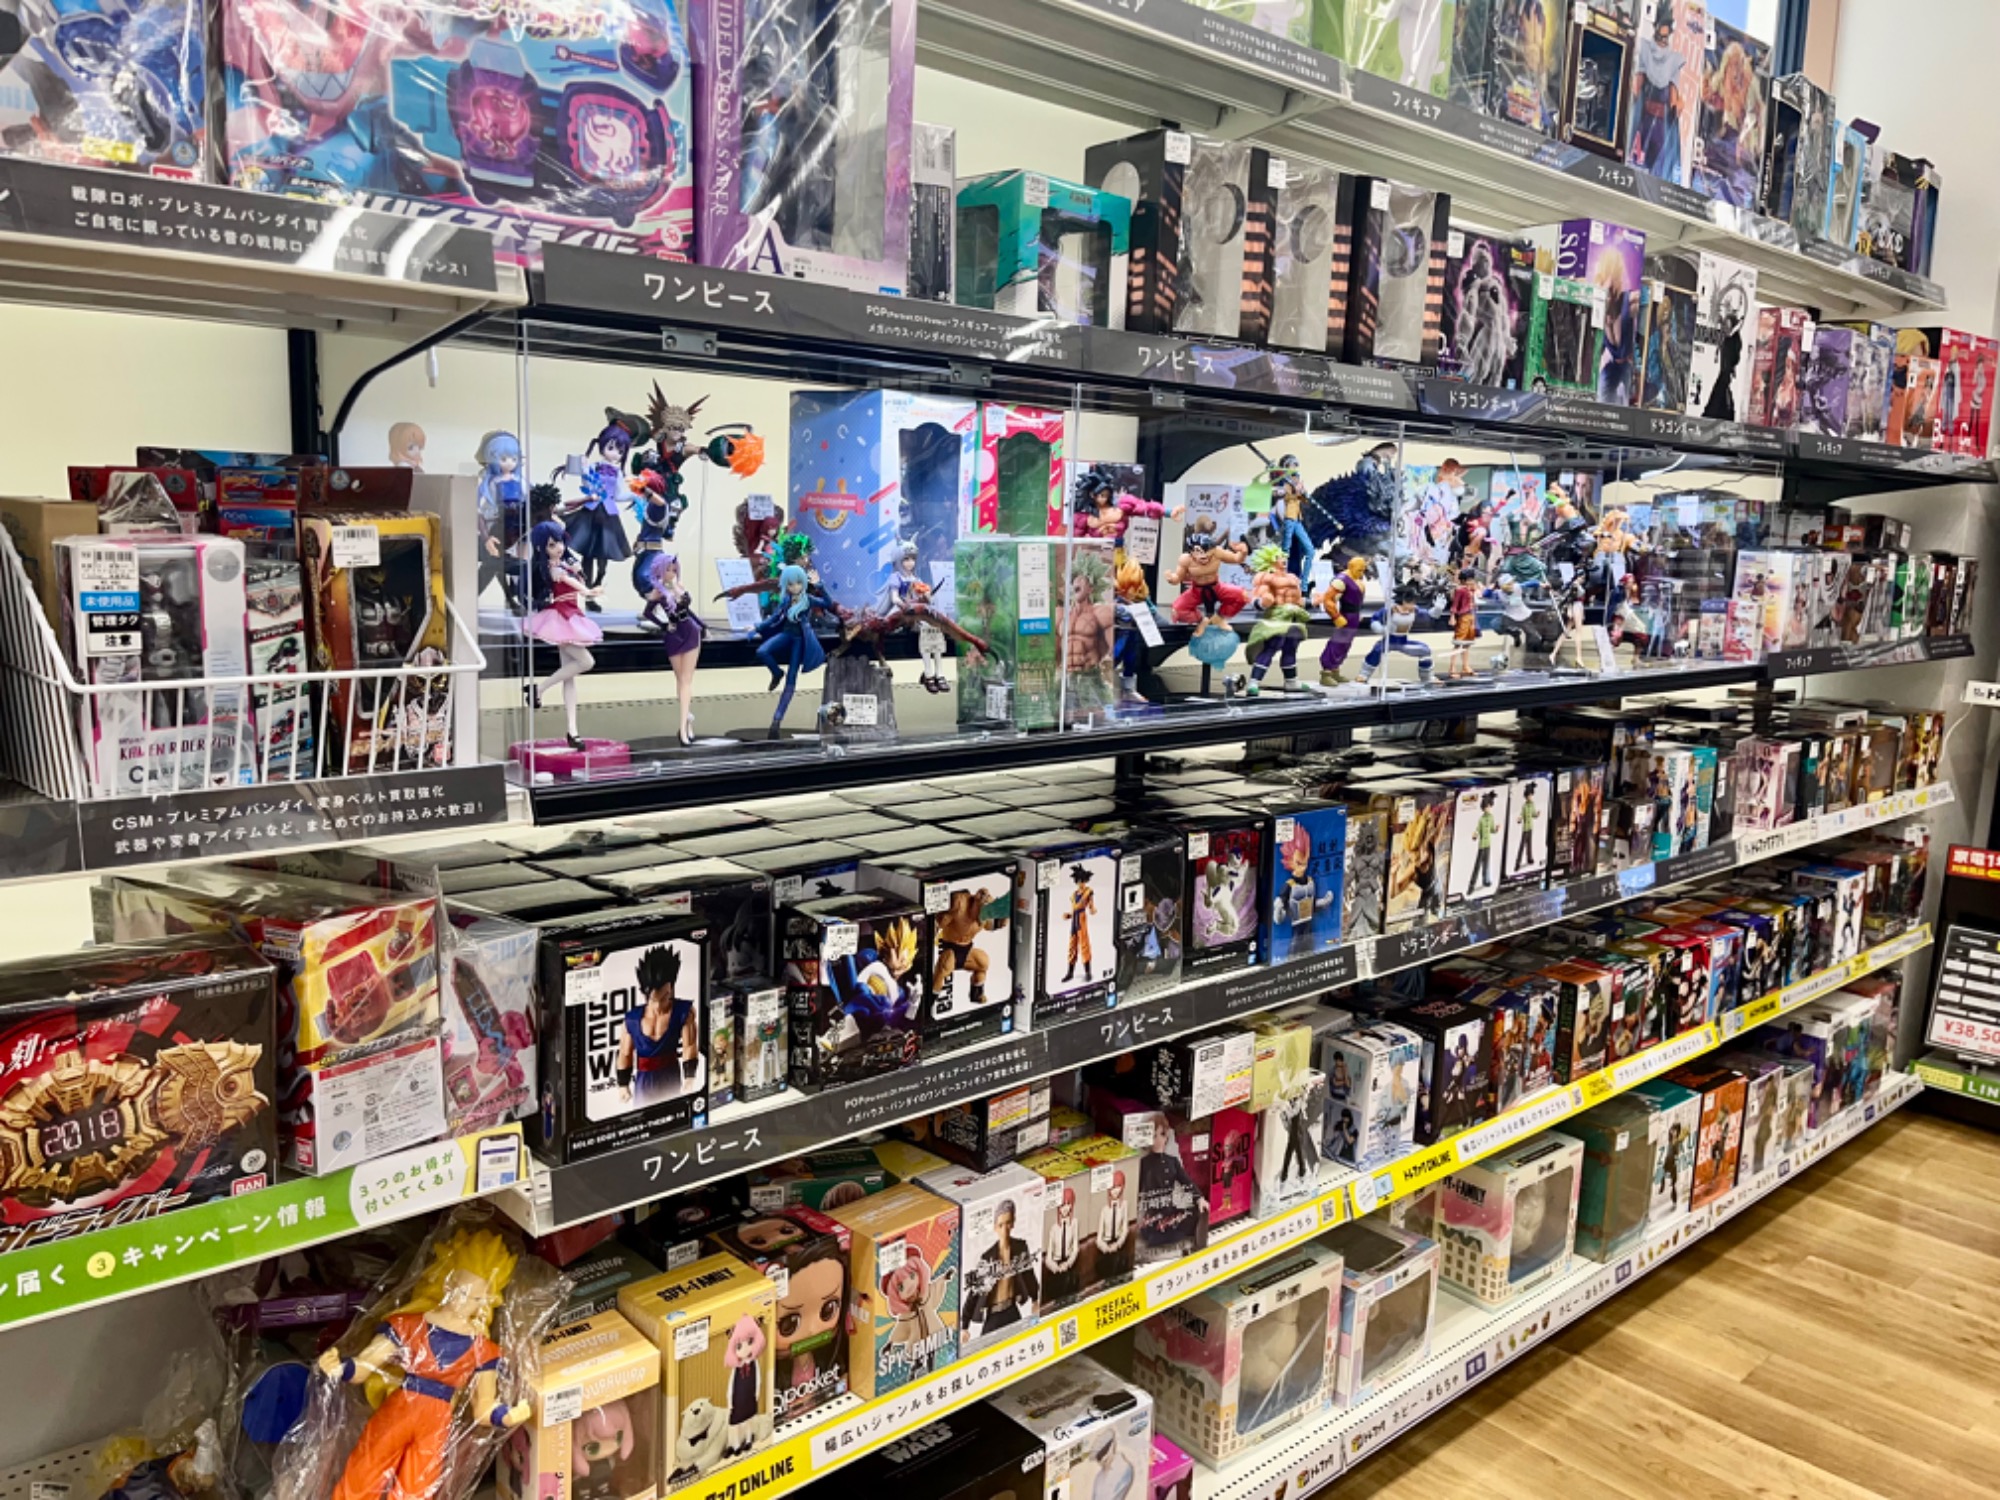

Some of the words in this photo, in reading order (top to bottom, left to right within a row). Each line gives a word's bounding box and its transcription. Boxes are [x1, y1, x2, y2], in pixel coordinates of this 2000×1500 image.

[1392, 90, 1442, 121] フィギュア
[643, 272, 775, 314] ワンピース
[1138, 346, 1215, 374] ワンピース
[1450, 390, 1521, 413] ドラゴンボール
[85, 595, 136, 607] 未使用品
[91, 614, 139, 627] 管理タグ
[104, 633, 132, 647] 注意
[1100, 1007, 1174, 1044] ワンピース
[44, 1107, 121, 1157] 2018
[643, 1127, 762, 1181] ワンピース
[122, 1195, 326, 1268] キャンペーン情報
[1095, 1292, 1135, 1318] TREFAC
[1095, 1303, 1141, 1331] FASHION
[825, 1340, 1046, 1454] 幅広いジャンルをお探しの方はこちら
[1391, 1374, 1460, 1424] ホビー・おもちゃ
